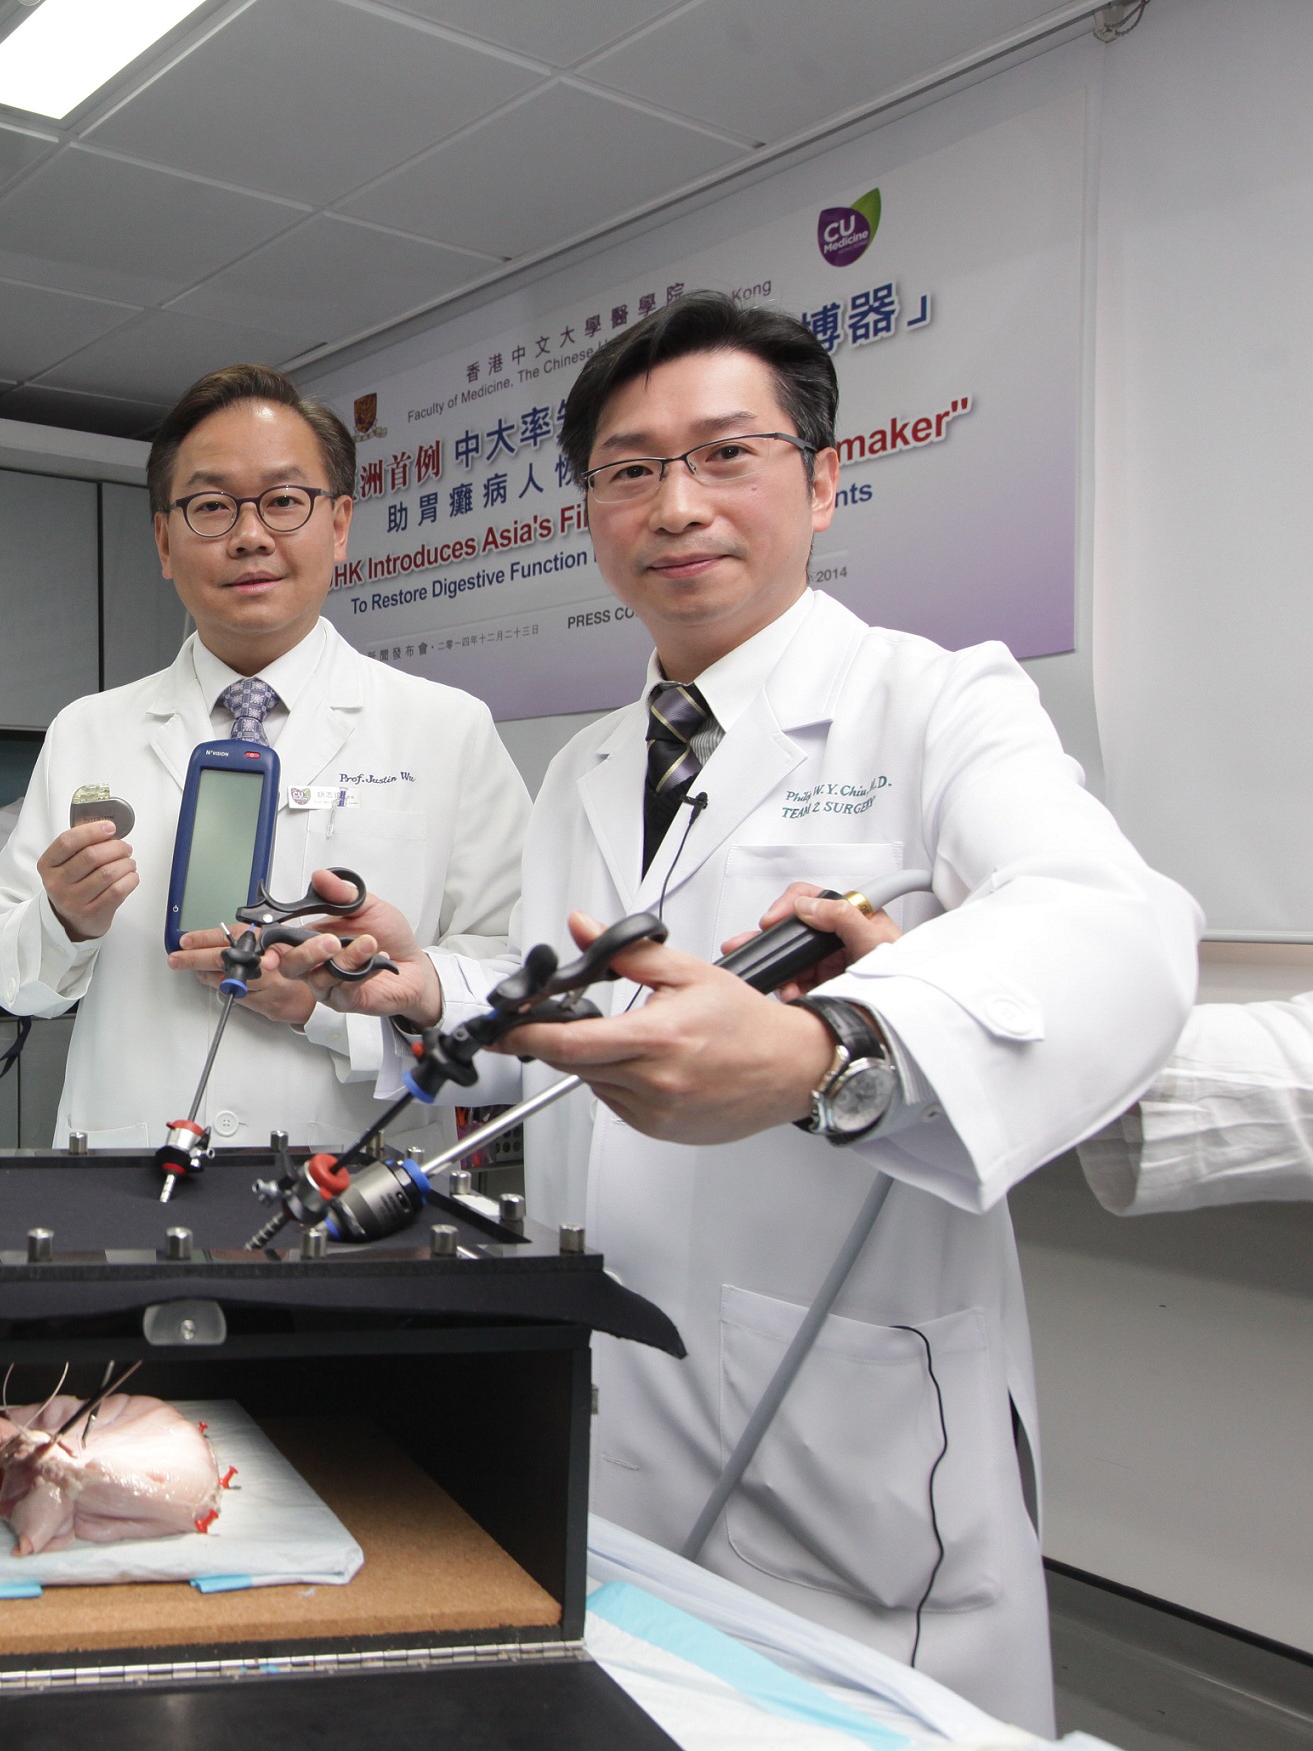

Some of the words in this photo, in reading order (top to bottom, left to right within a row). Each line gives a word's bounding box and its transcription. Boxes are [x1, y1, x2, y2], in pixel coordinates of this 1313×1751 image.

[823, 230, 868, 254] Medicine
[824, 214, 855, 243] CU
[407, 402, 444, 424] Faculty
[447, 394, 459, 409] of
[461, 376, 514, 404] Medicine,
[518, 366, 540, 384] The
[543, 346, 594, 374] Chinese
[354, 440, 440, 499] 洲首例
[330, 560, 363, 588] HK
[368, 538, 476, 580] Introduces
[481, 515, 552, 553] Asia's
[351, 597, 368, 614] To
[371, 586, 427, 611] Restore
[432, 567, 505, 599] Digestive
[510, 551, 587, 581] Function
[567, 609, 611, 629] PRESS
[614, 607, 636, 621] CO
[816, 566, 848, 583] 2014
[339, 773, 365, 785] Prof.
[365, 774, 397, 784] Justin
[400, 771, 416, 782] Wu
[812, 801, 821, 813] 2
[823, 796, 877, 815] SURGERY
